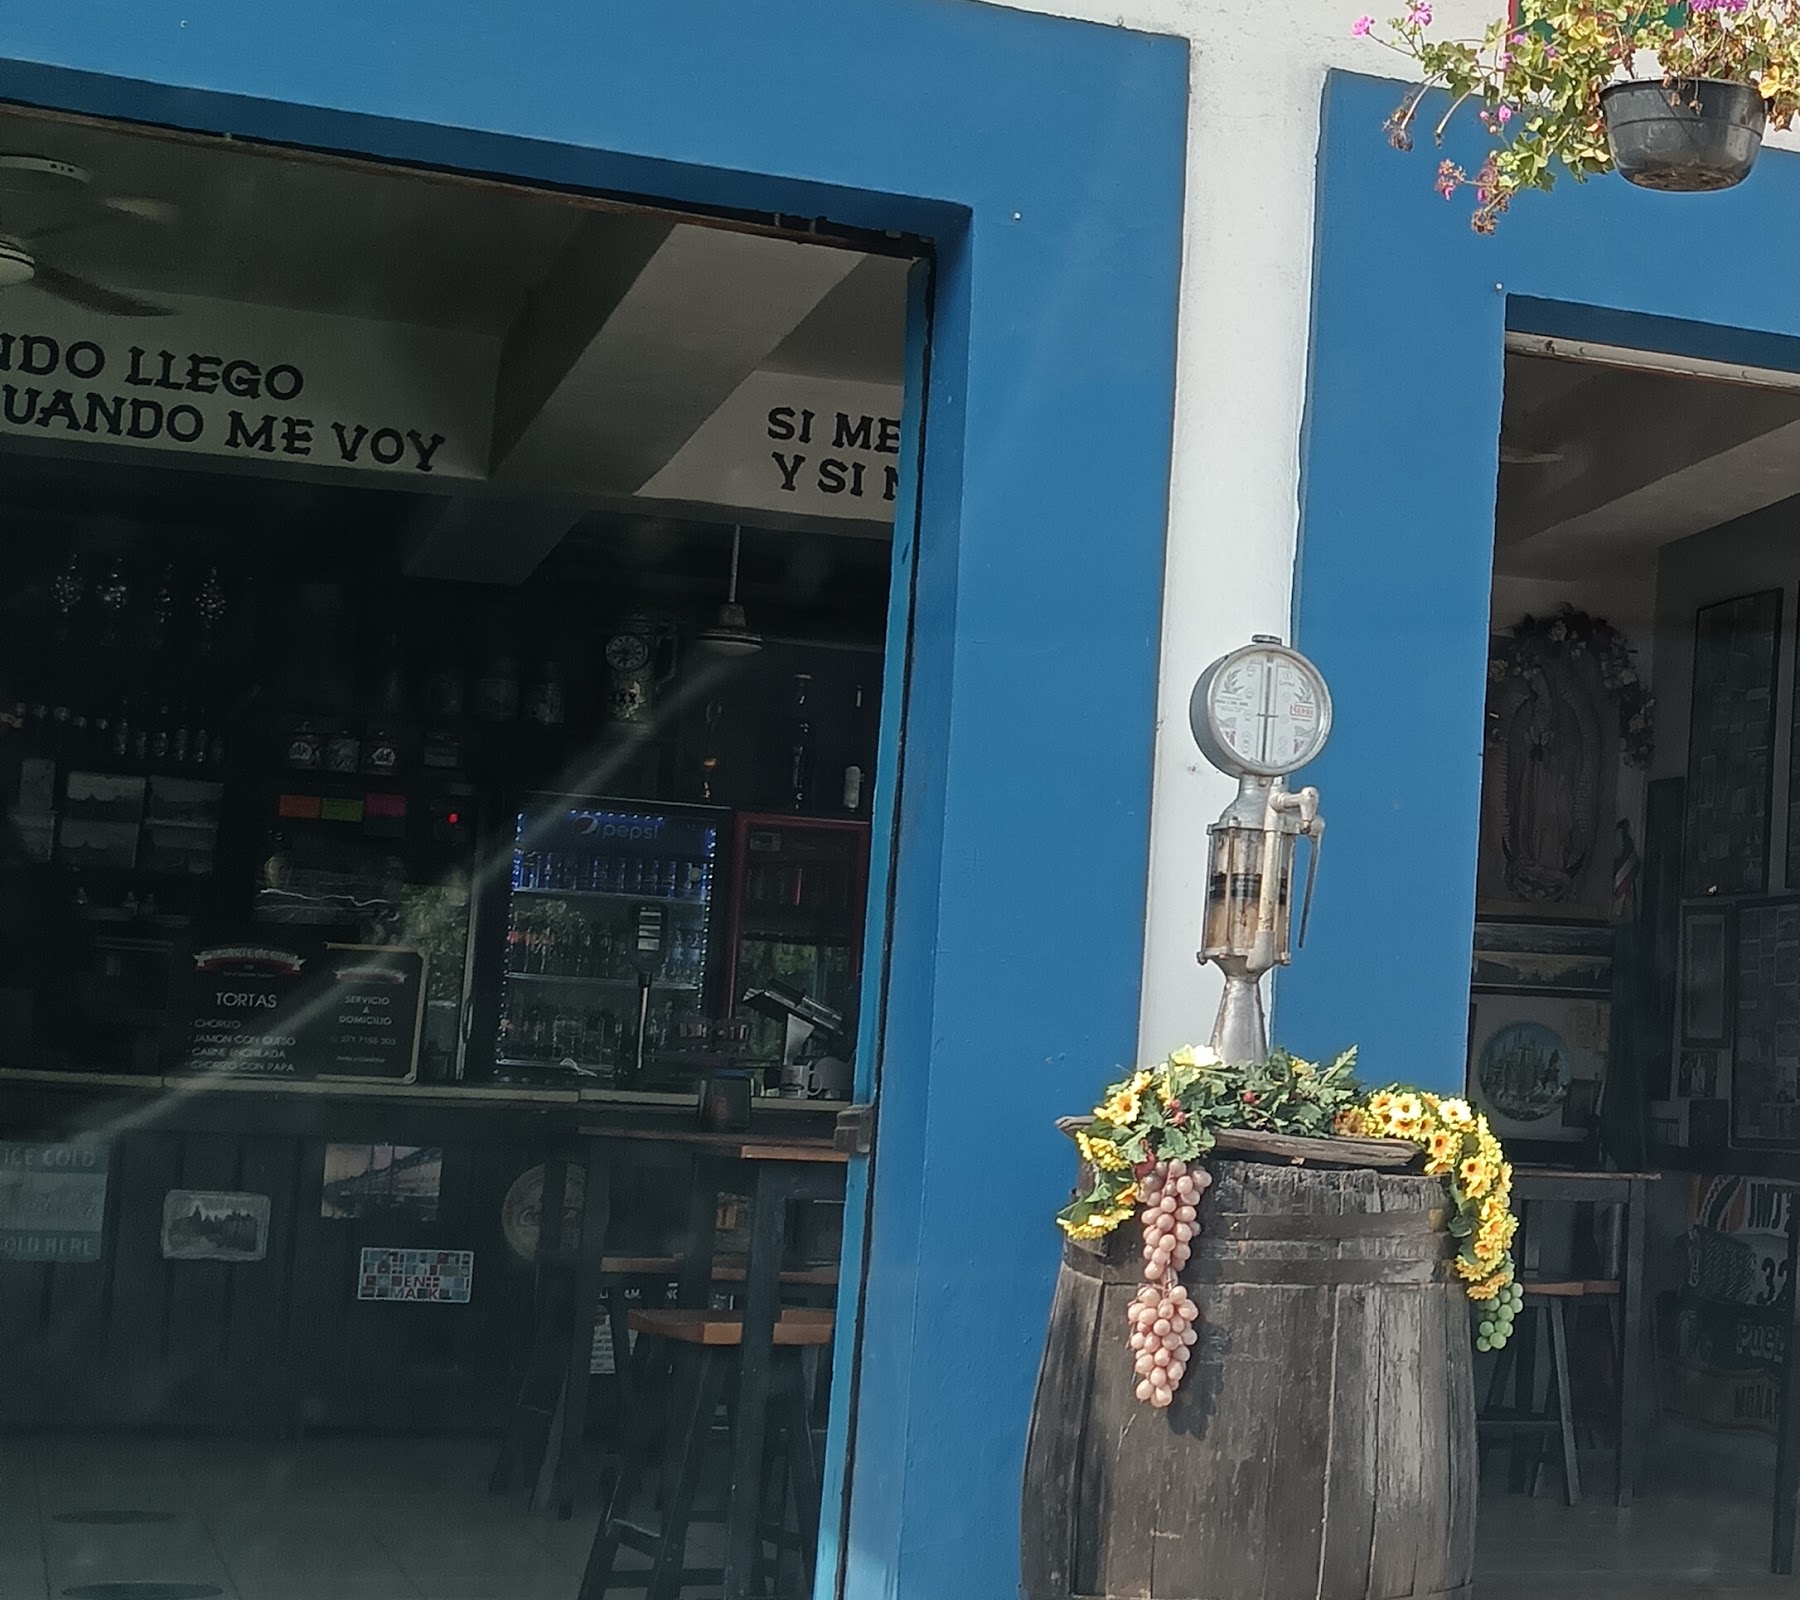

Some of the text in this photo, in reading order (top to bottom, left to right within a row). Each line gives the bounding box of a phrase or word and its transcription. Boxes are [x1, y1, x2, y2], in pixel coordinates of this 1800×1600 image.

[124, 346, 304, 401] LLEGO
[224, 410, 314, 456] ME
[331, 421, 446, 473] VOY
[767, 406, 901, 454] SI ME
[771, 451, 806, 492] Y
[817, 458, 866, 497] SI
[602, 824, 659, 841] pepsi
[215, 991, 278, 1009] TORTAS
[344, 994, 391, 1006] SERVICIO
[266, 1061, 296, 1073] PAPA
